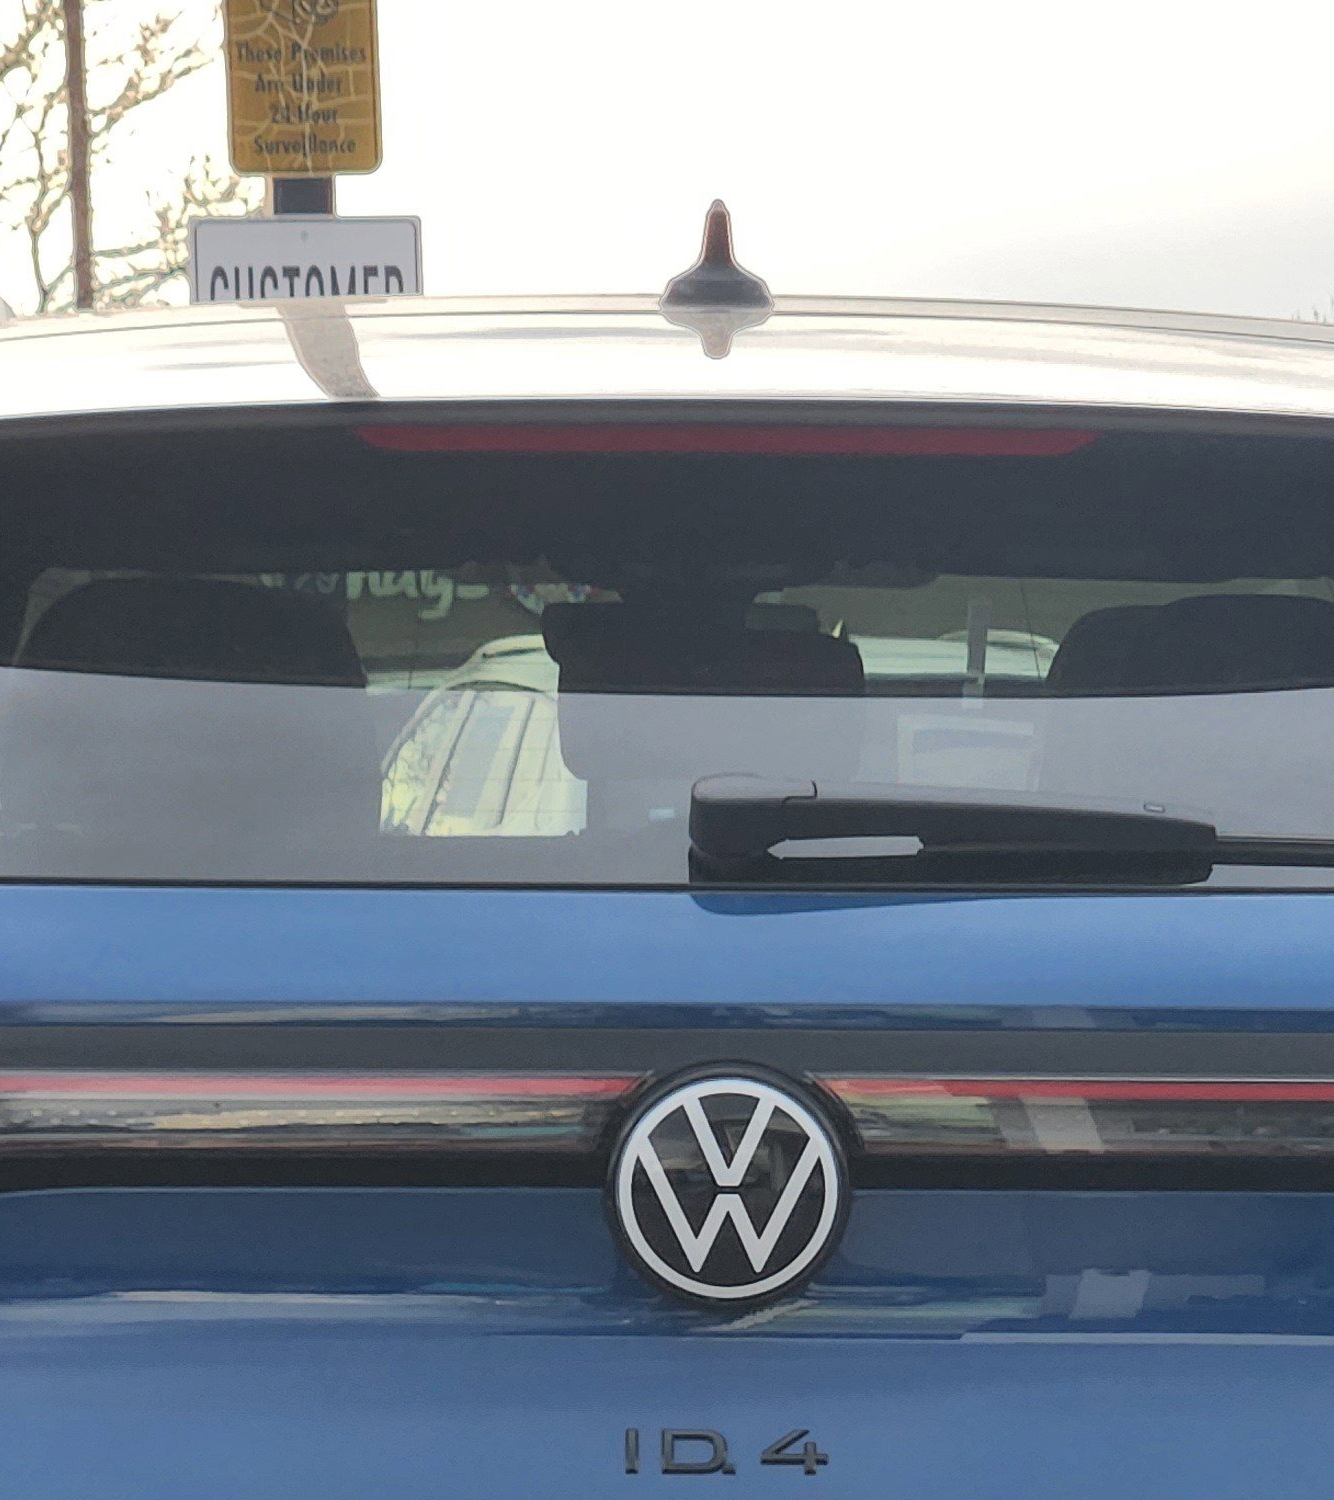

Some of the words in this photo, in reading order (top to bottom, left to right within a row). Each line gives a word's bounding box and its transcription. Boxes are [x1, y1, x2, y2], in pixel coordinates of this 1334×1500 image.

[237, 42, 282, 61] These
[291, 42, 367, 61] Premises
[292, 73, 342, 93] Under
[297, 103, 338, 124] Hour
[254, 133, 357, 157] Surveillance
